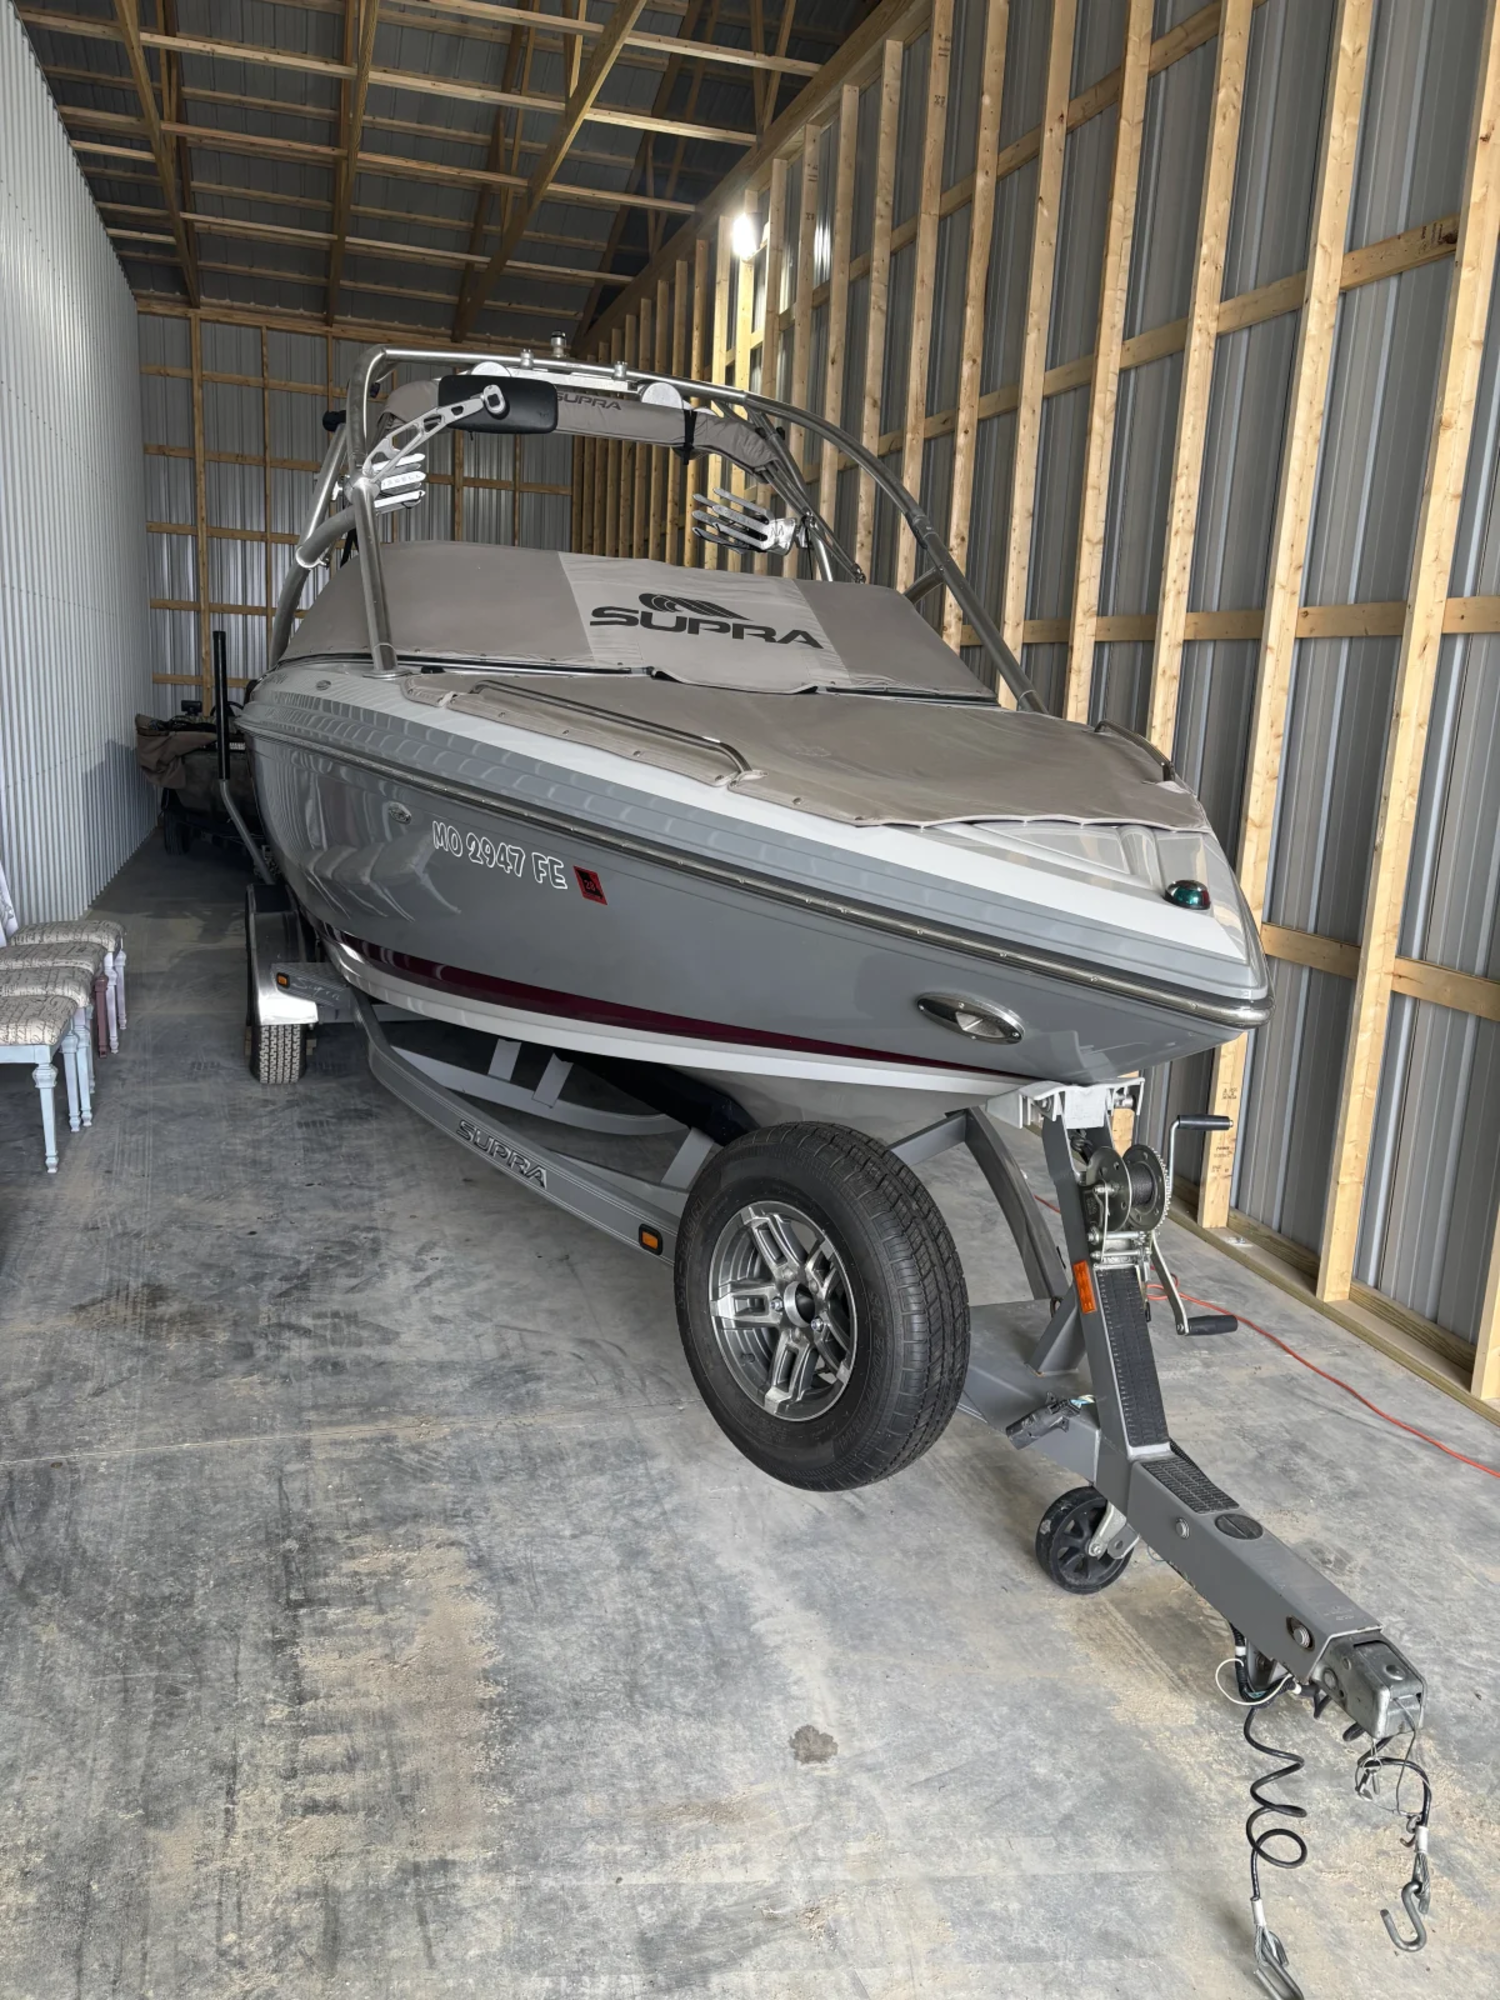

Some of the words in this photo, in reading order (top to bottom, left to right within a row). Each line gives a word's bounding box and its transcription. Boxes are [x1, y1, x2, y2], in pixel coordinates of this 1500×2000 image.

[590, 606, 824, 649] SUPRA
[432, 821, 463, 857] MO
[466, 832, 526, 877] 2947
[532, 852, 568, 889] FE
[456, 1120, 548, 1189] SUPRA
